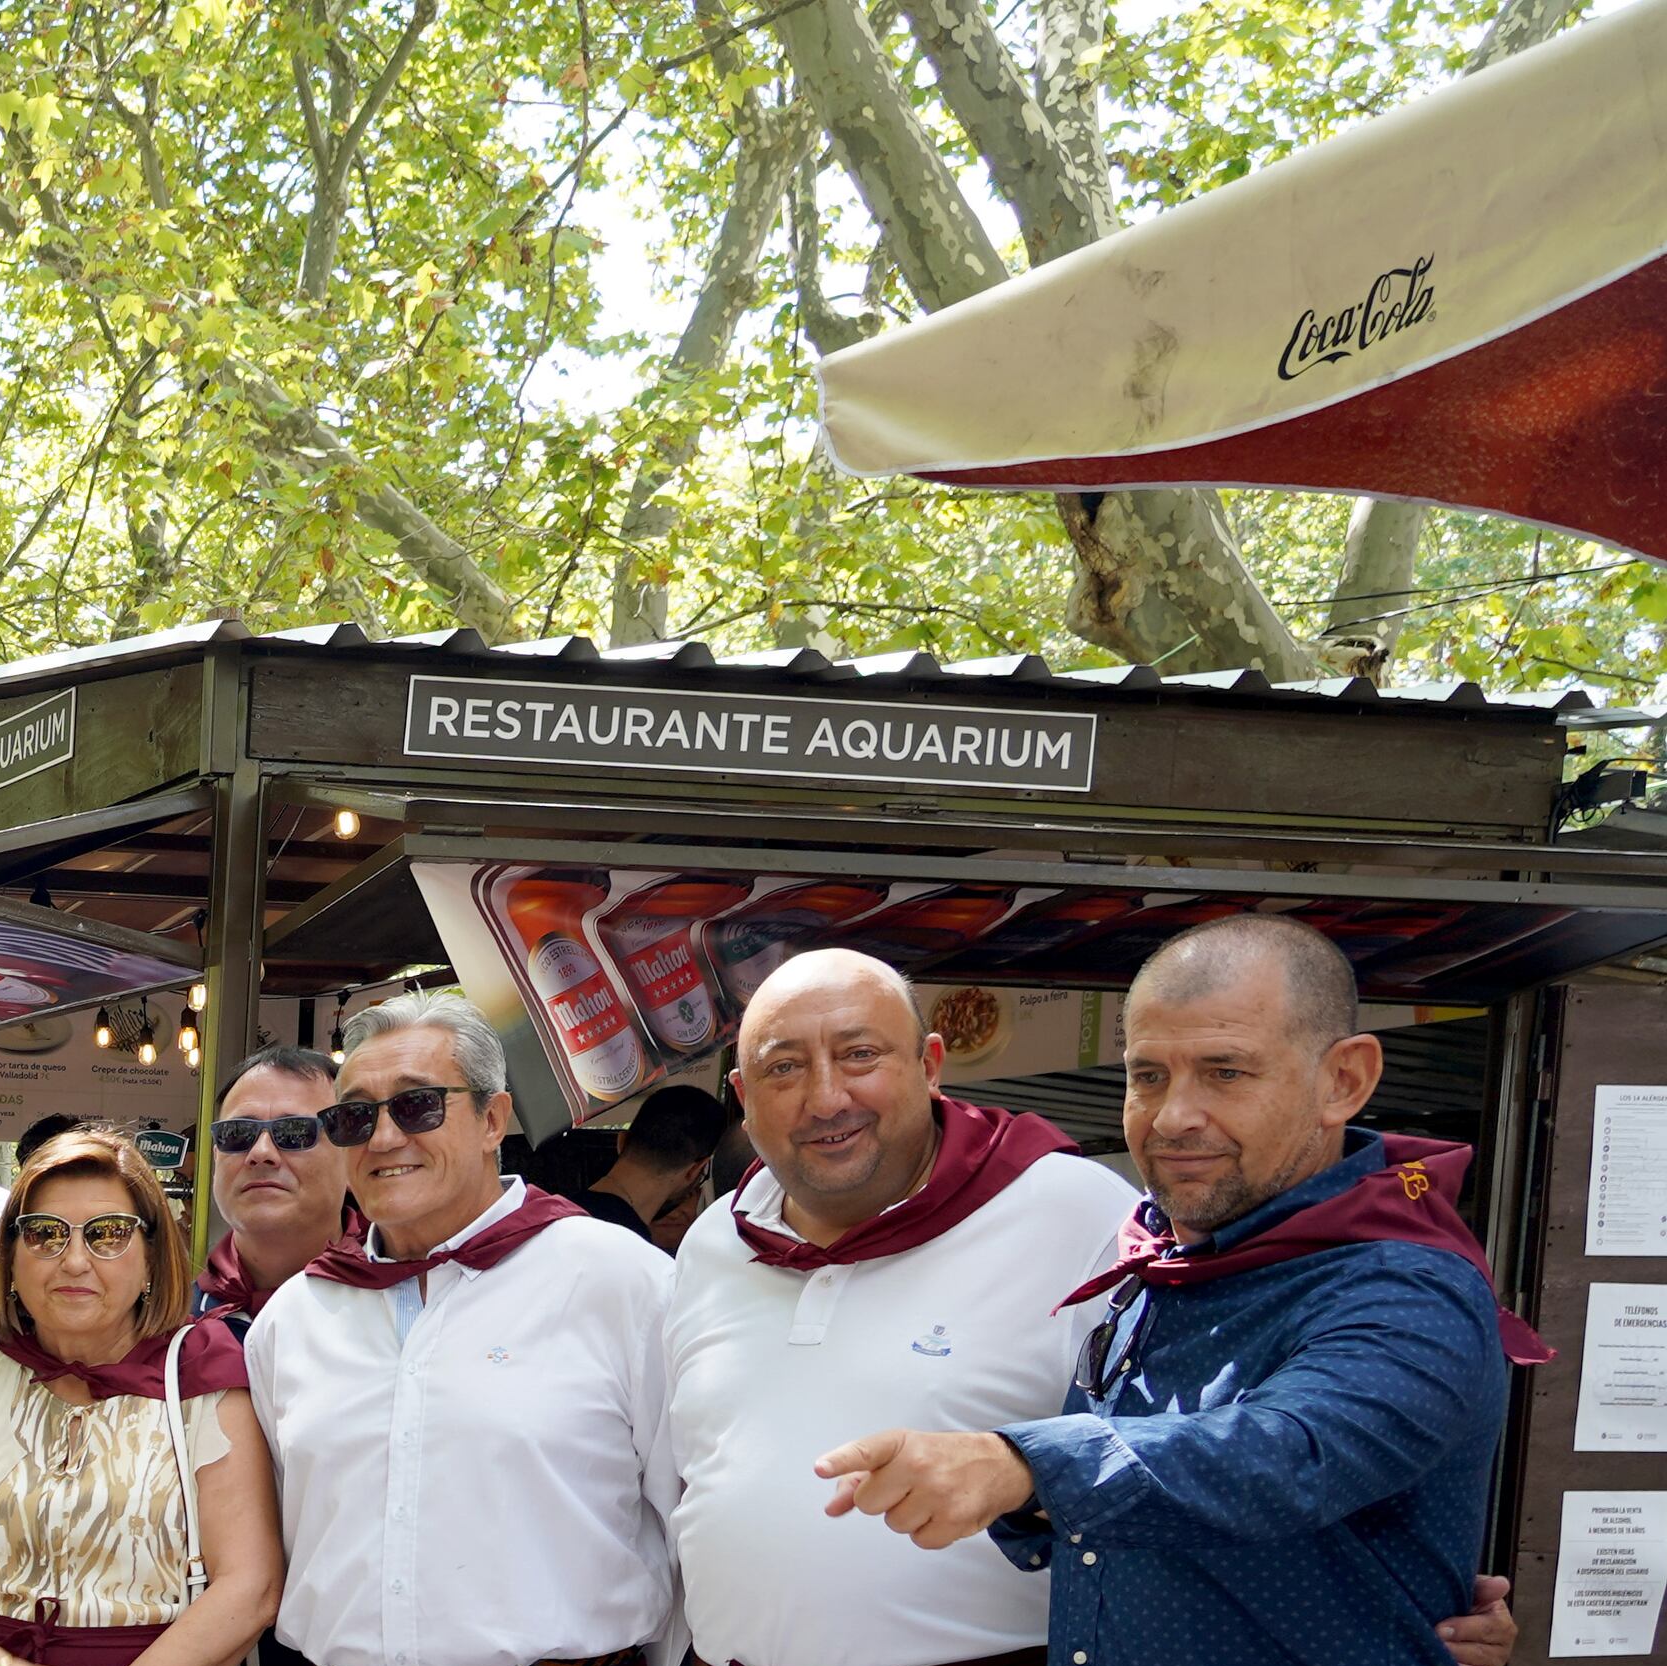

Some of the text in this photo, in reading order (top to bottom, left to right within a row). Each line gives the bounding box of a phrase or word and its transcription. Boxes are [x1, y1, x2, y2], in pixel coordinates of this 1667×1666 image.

[1277, 252, 1435, 381] Coca-Cola
[428, 696, 1072, 769] RESTAURANTE AQUARIUM
[630, 944, 690, 986] Mahou
[554, 986, 614, 1031] Mahou
[139, 1140, 179, 1154] Mahou
